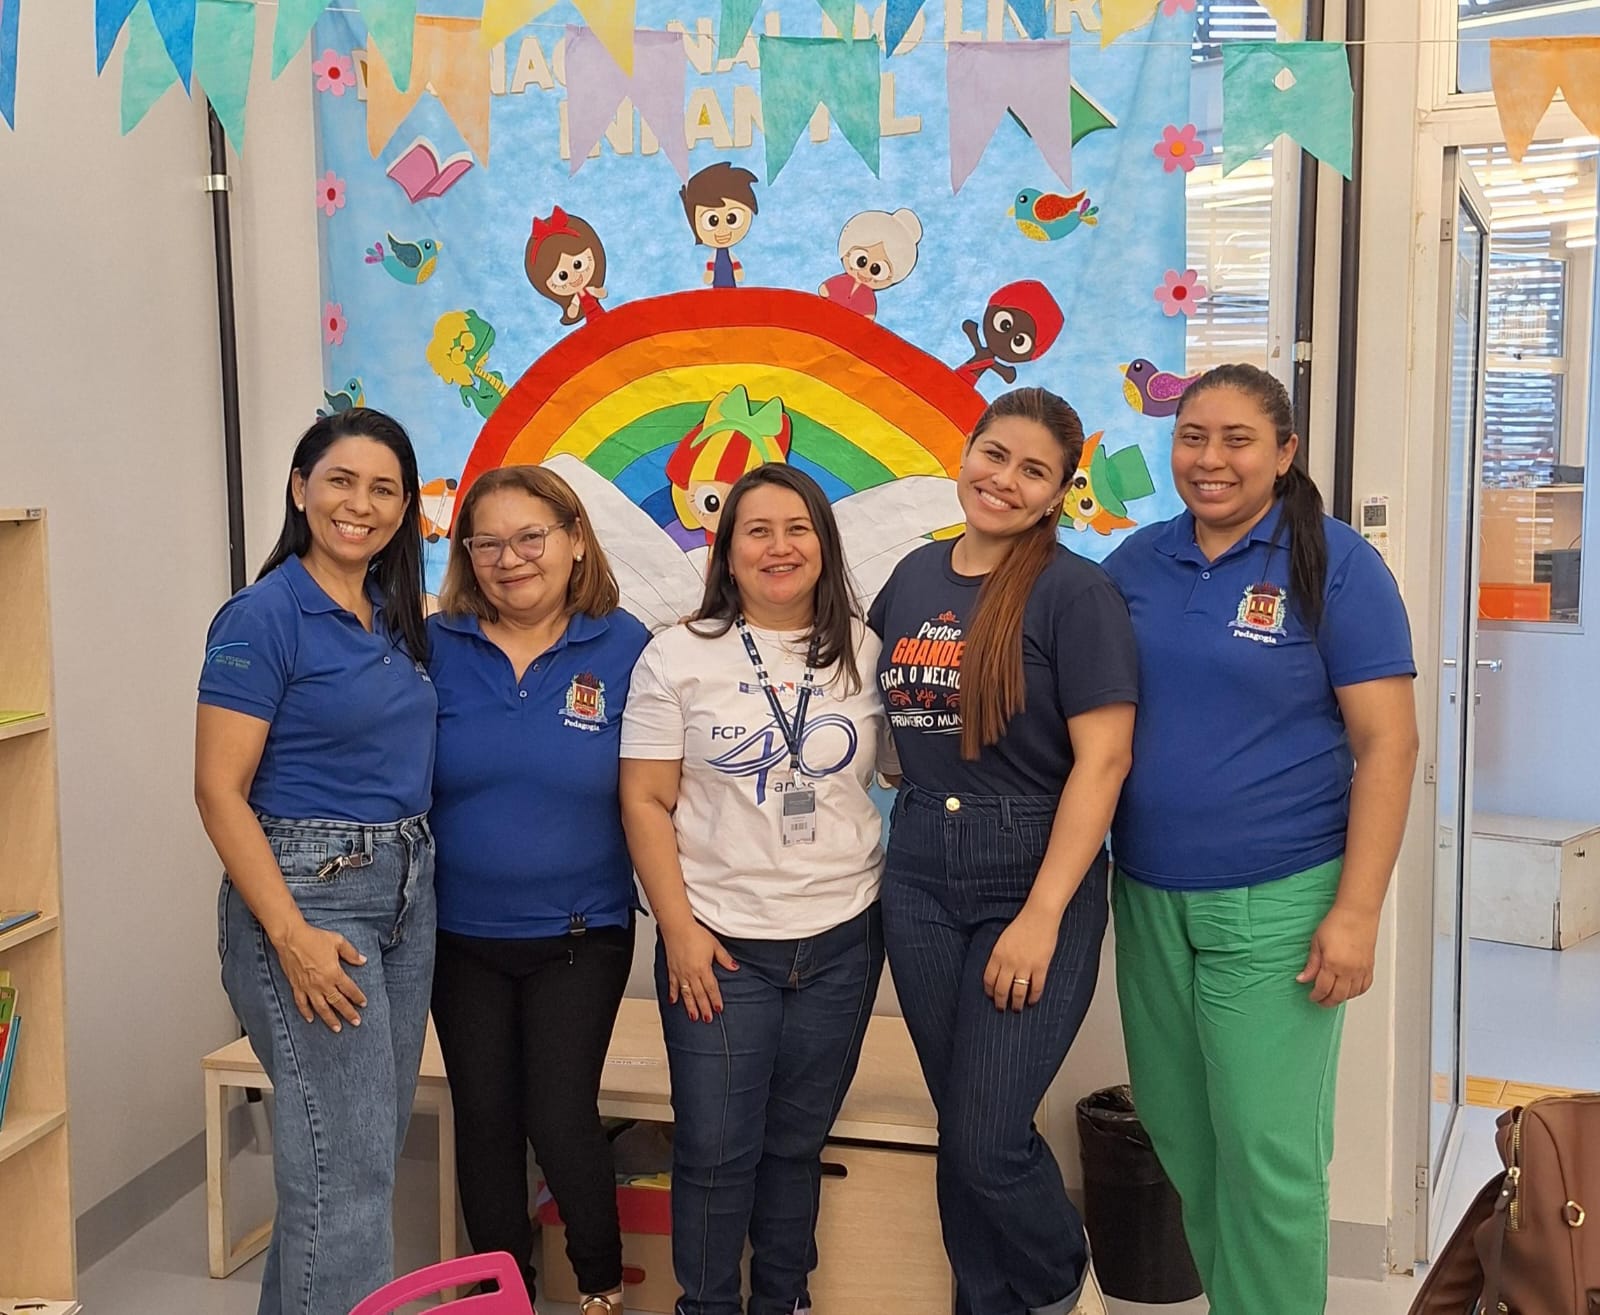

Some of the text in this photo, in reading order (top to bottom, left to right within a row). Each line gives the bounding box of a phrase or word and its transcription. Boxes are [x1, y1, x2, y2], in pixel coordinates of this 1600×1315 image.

[917, 621, 962, 641] Pense
[891, 637, 967, 668] GRANDE
[880, 666, 961, 692] FAÇA O MELHO
[891, 714, 963, 728] PRIMEIRO MUN
[711, 725, 747, 741] FCP
[774, 780, 815, 793] ans
